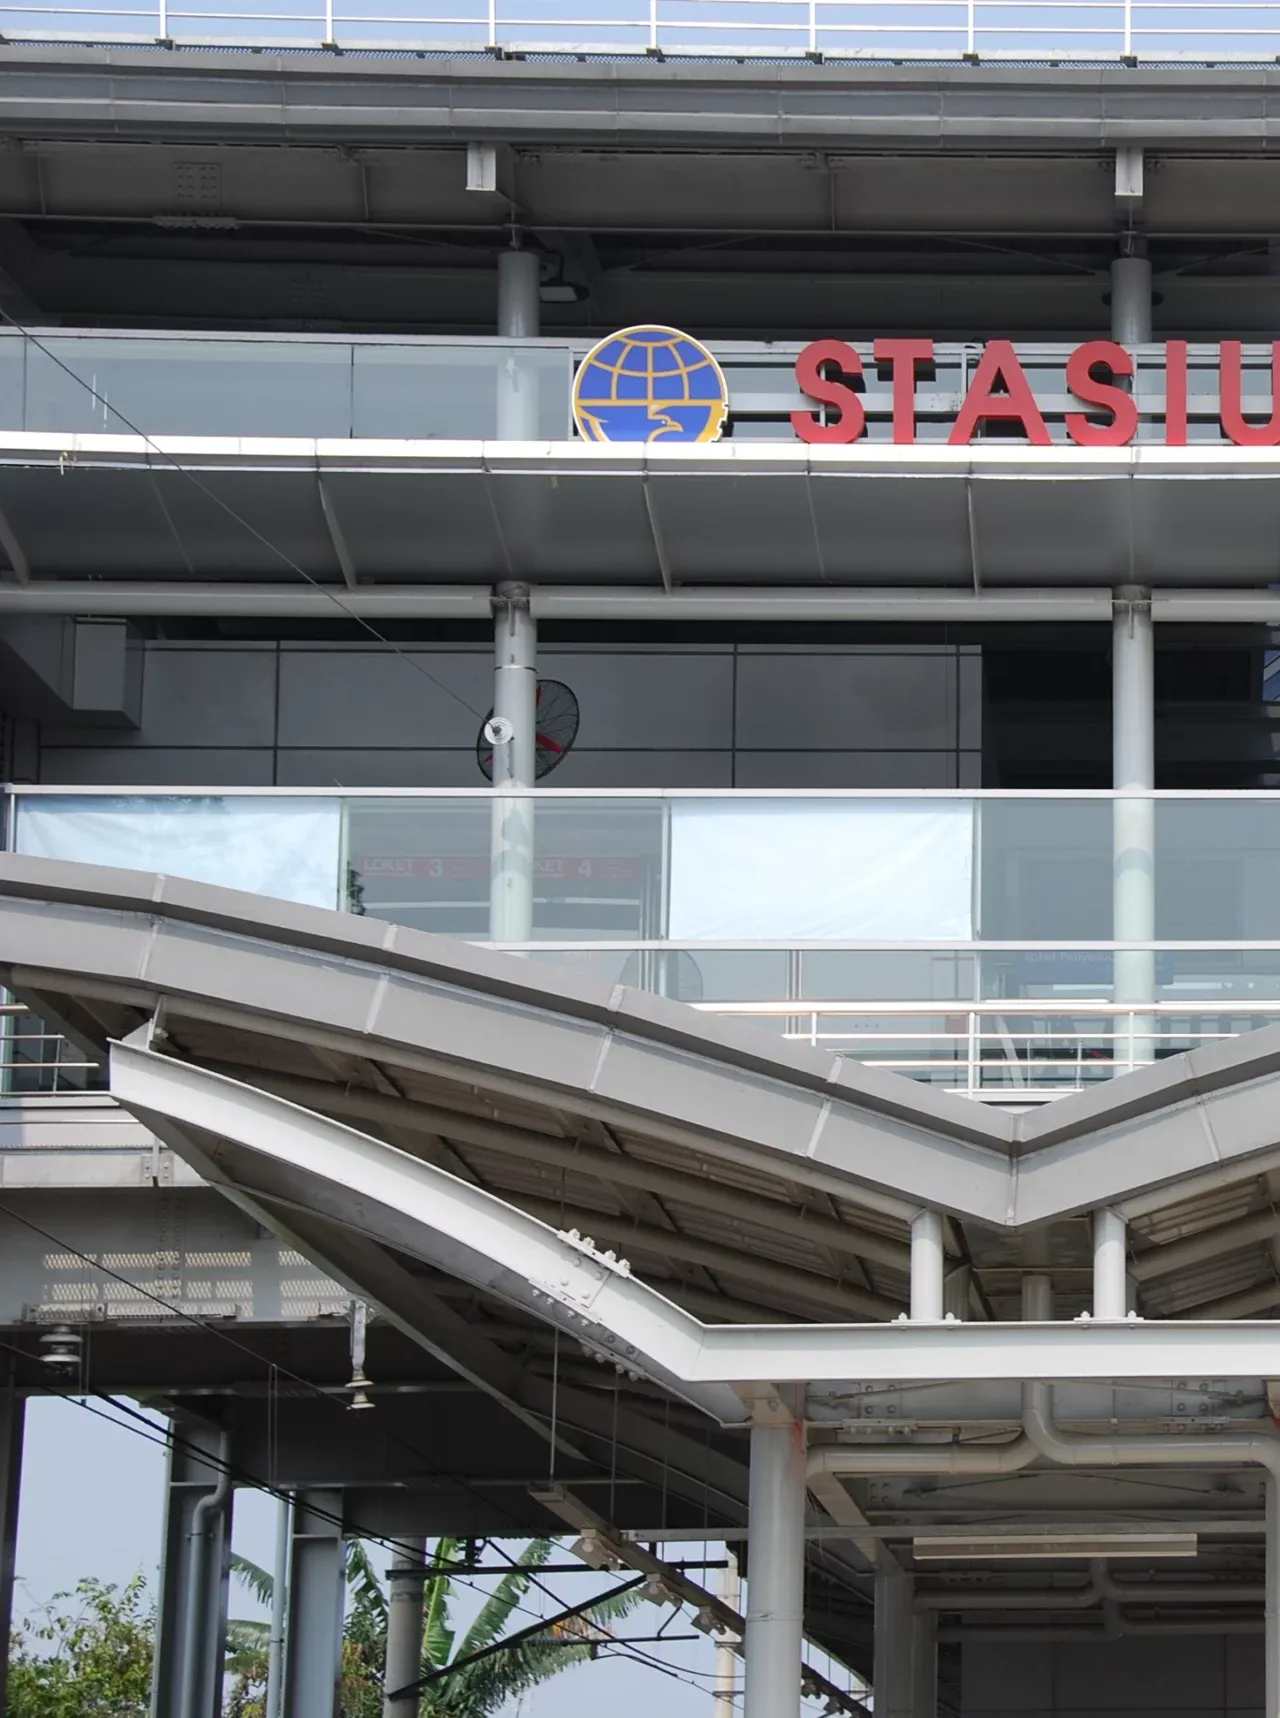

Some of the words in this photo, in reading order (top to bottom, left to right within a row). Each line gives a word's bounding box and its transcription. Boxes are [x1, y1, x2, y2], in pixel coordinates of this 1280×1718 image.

[364, 858, 415, 872] LOKET
[428, 858, 443, 878] 3
[577, 858, 593, 878] 4
